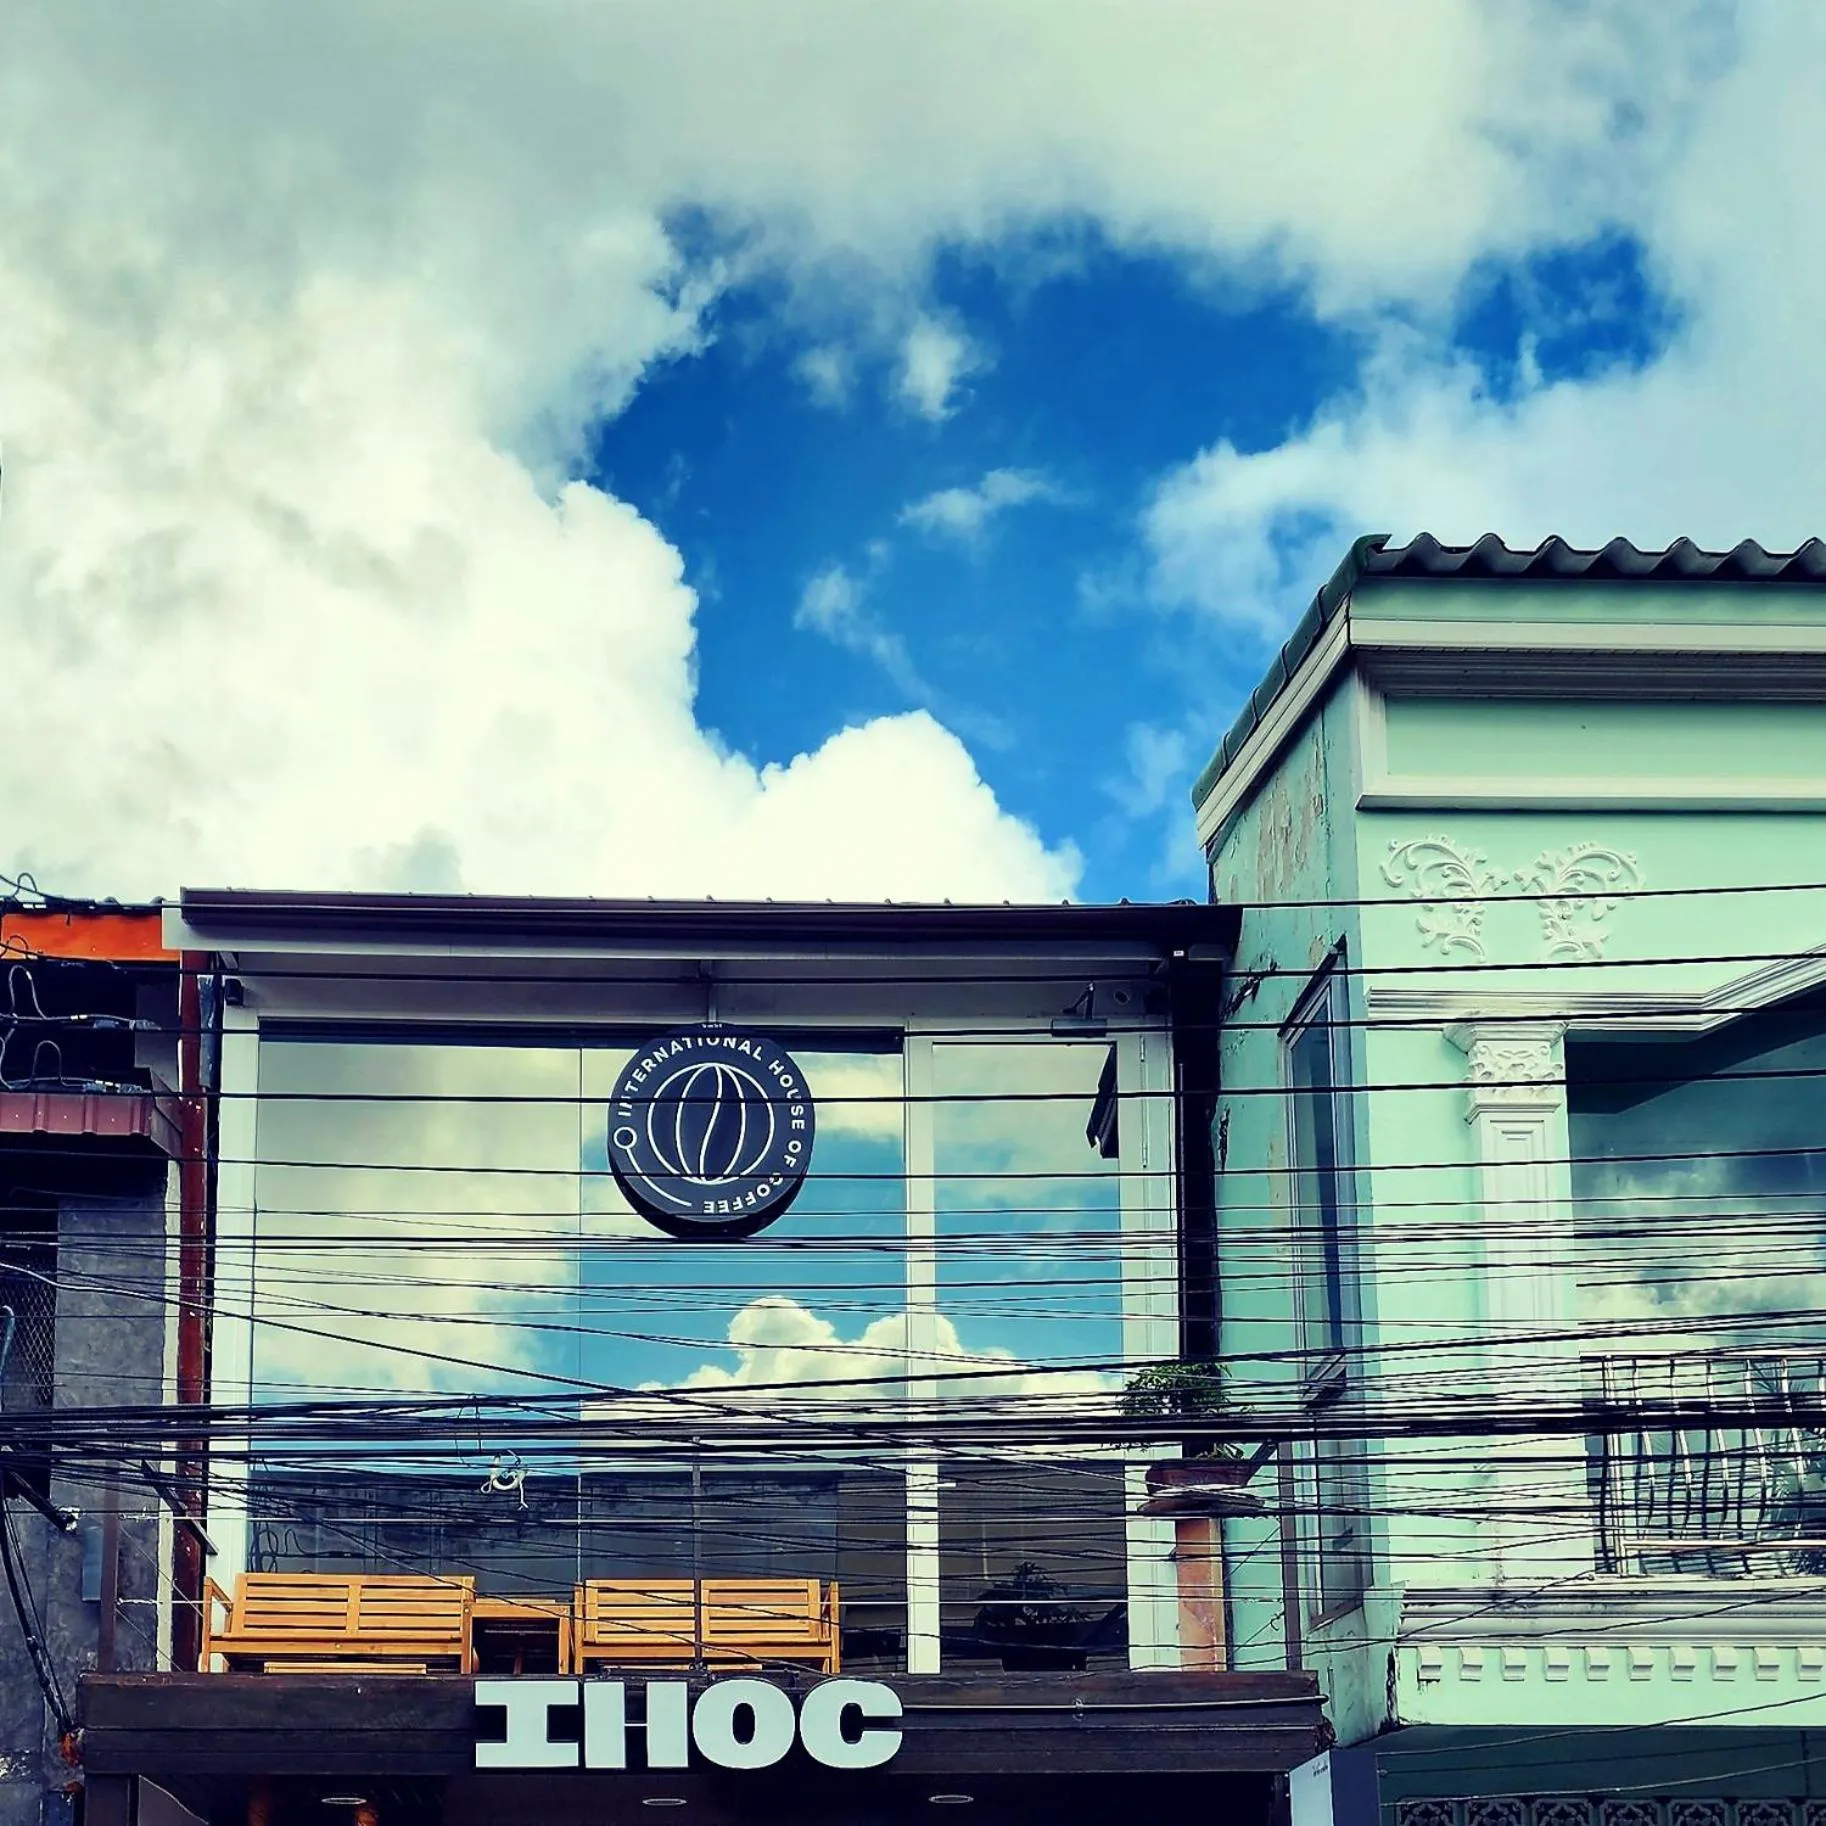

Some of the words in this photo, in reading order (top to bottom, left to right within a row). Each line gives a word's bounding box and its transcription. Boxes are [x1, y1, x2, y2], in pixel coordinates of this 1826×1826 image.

[768, 1060, 806, 1130] HOUSE
[783, 1140, 802, 1168] OF
[703, 1172, 784, 1214] COFFEE
[475, 1679, 903, 1769] IHOC
